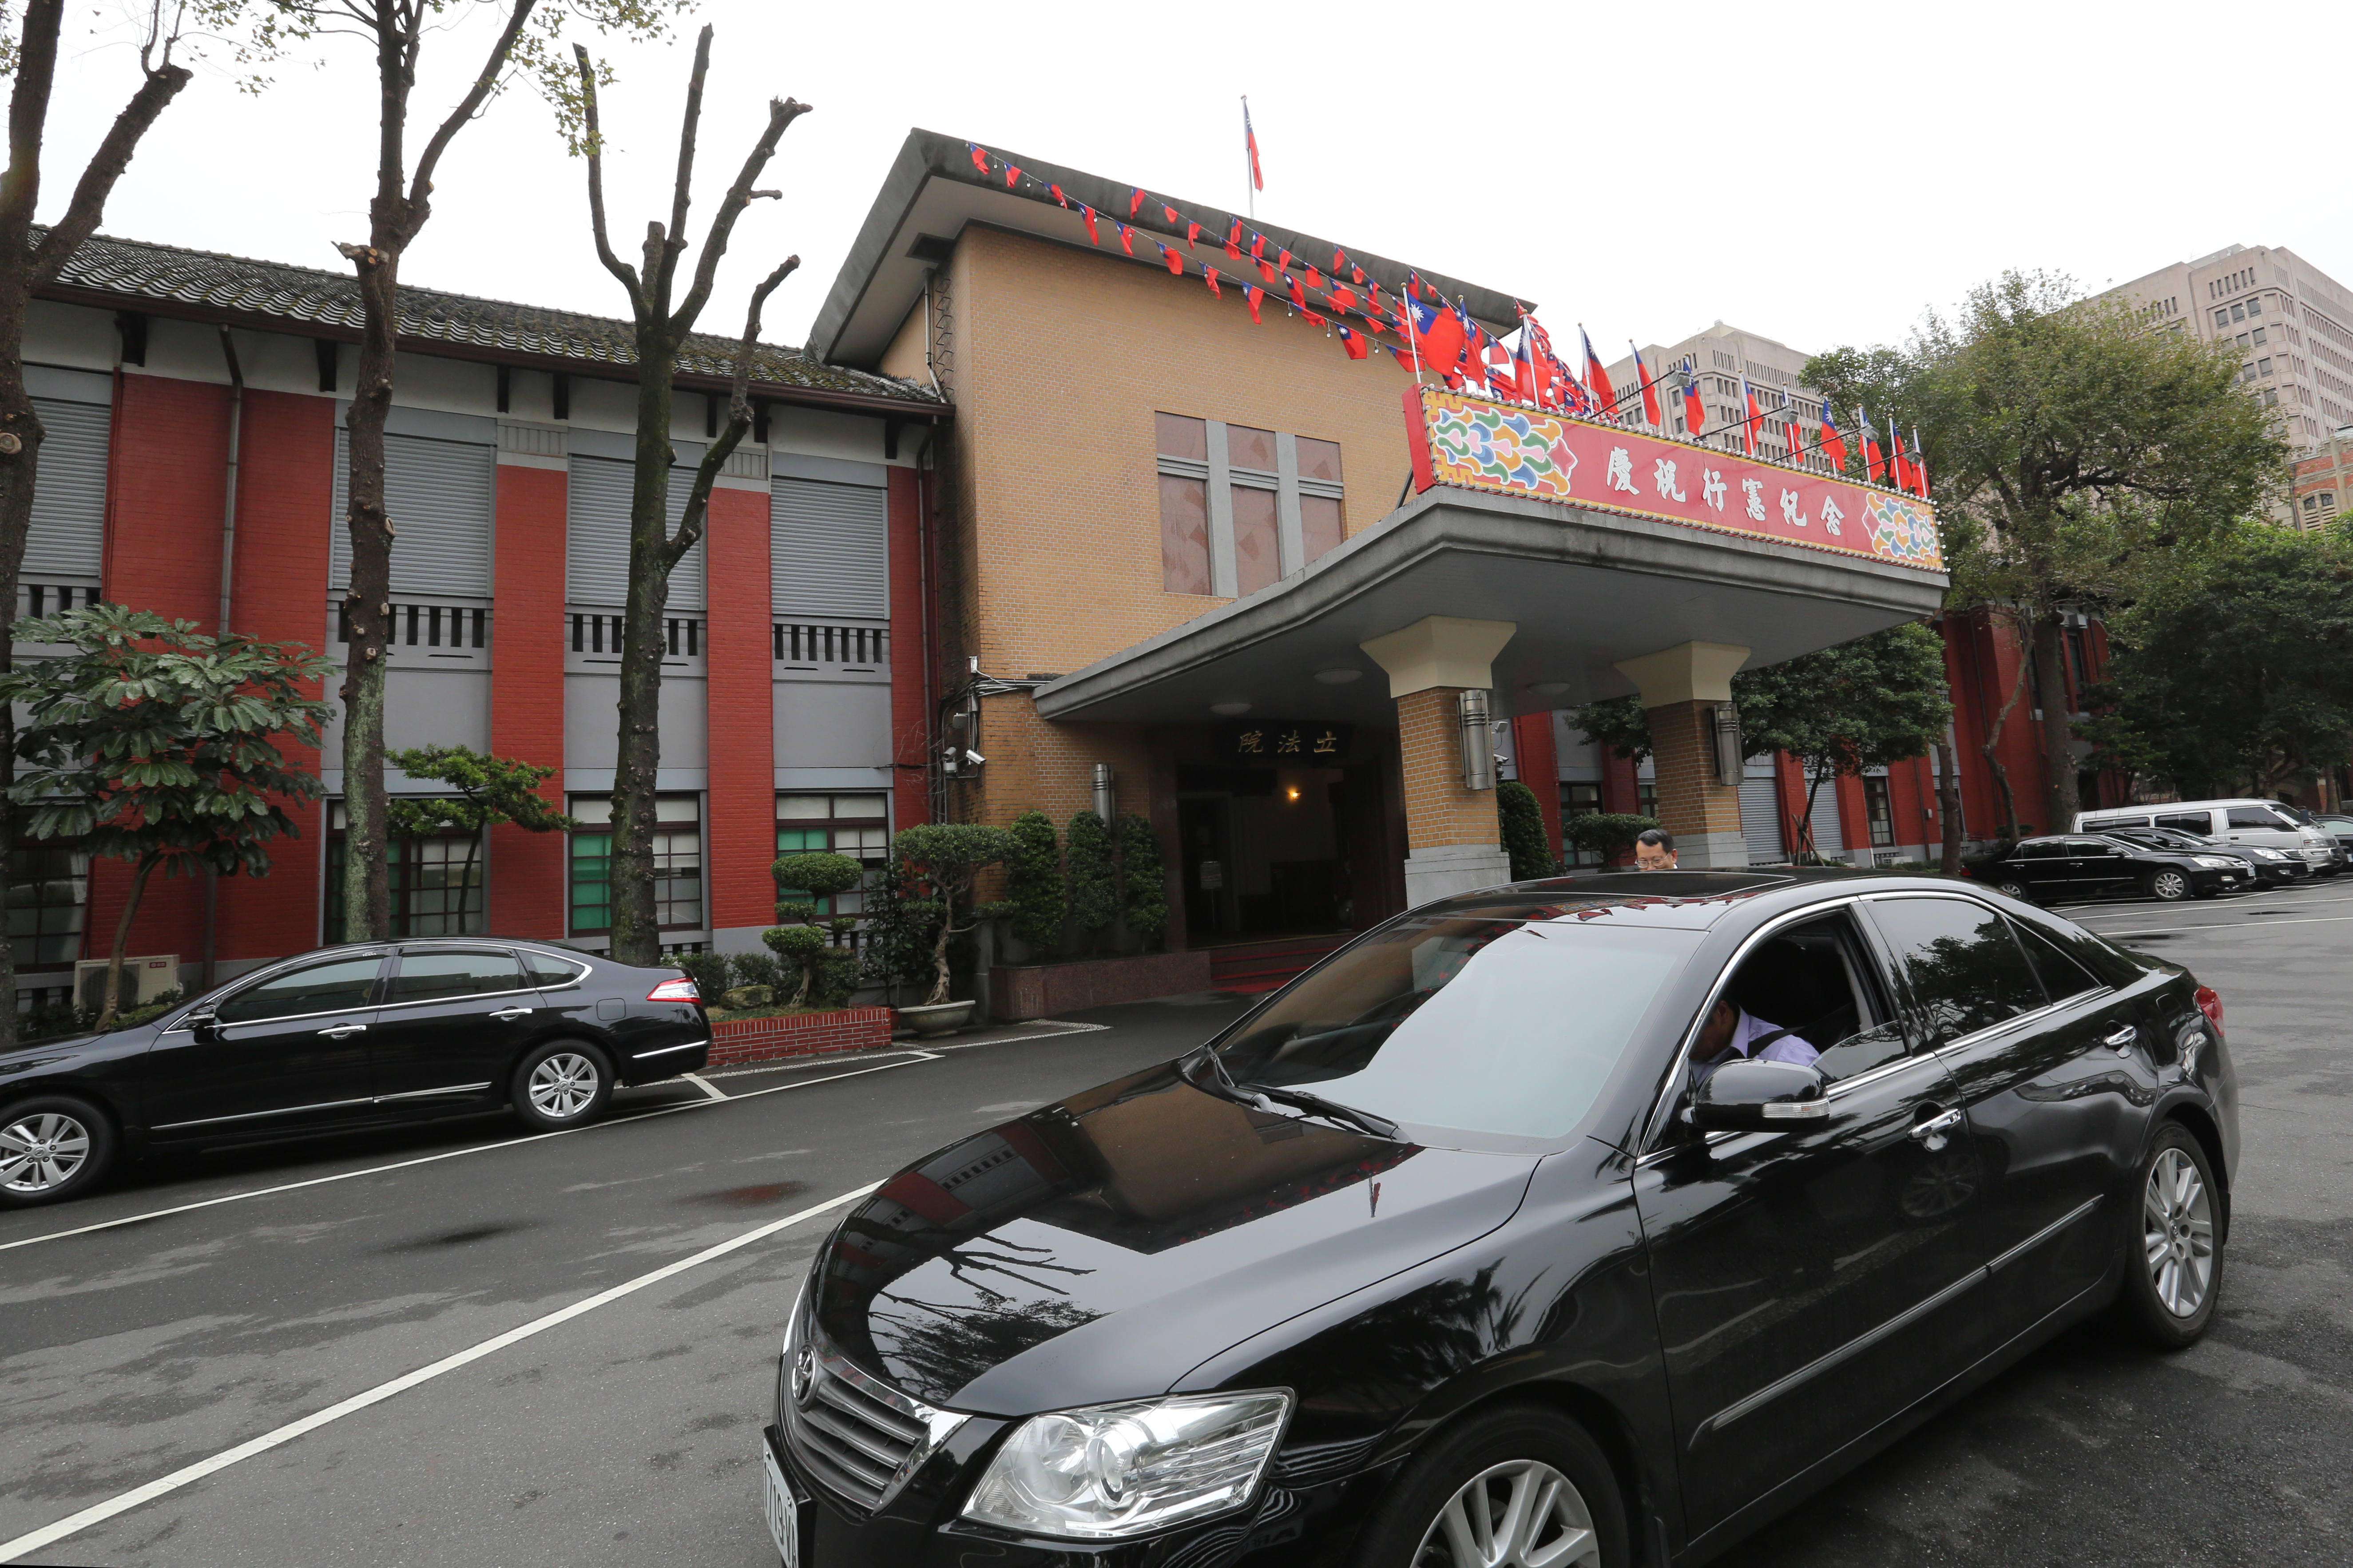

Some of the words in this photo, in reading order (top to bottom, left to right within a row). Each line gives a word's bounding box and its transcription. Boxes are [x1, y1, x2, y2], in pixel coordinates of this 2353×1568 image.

[1606, 446, 1845, 536] 慶祝行憲紀念
[1238, 730, 1337, 753] 立法院
